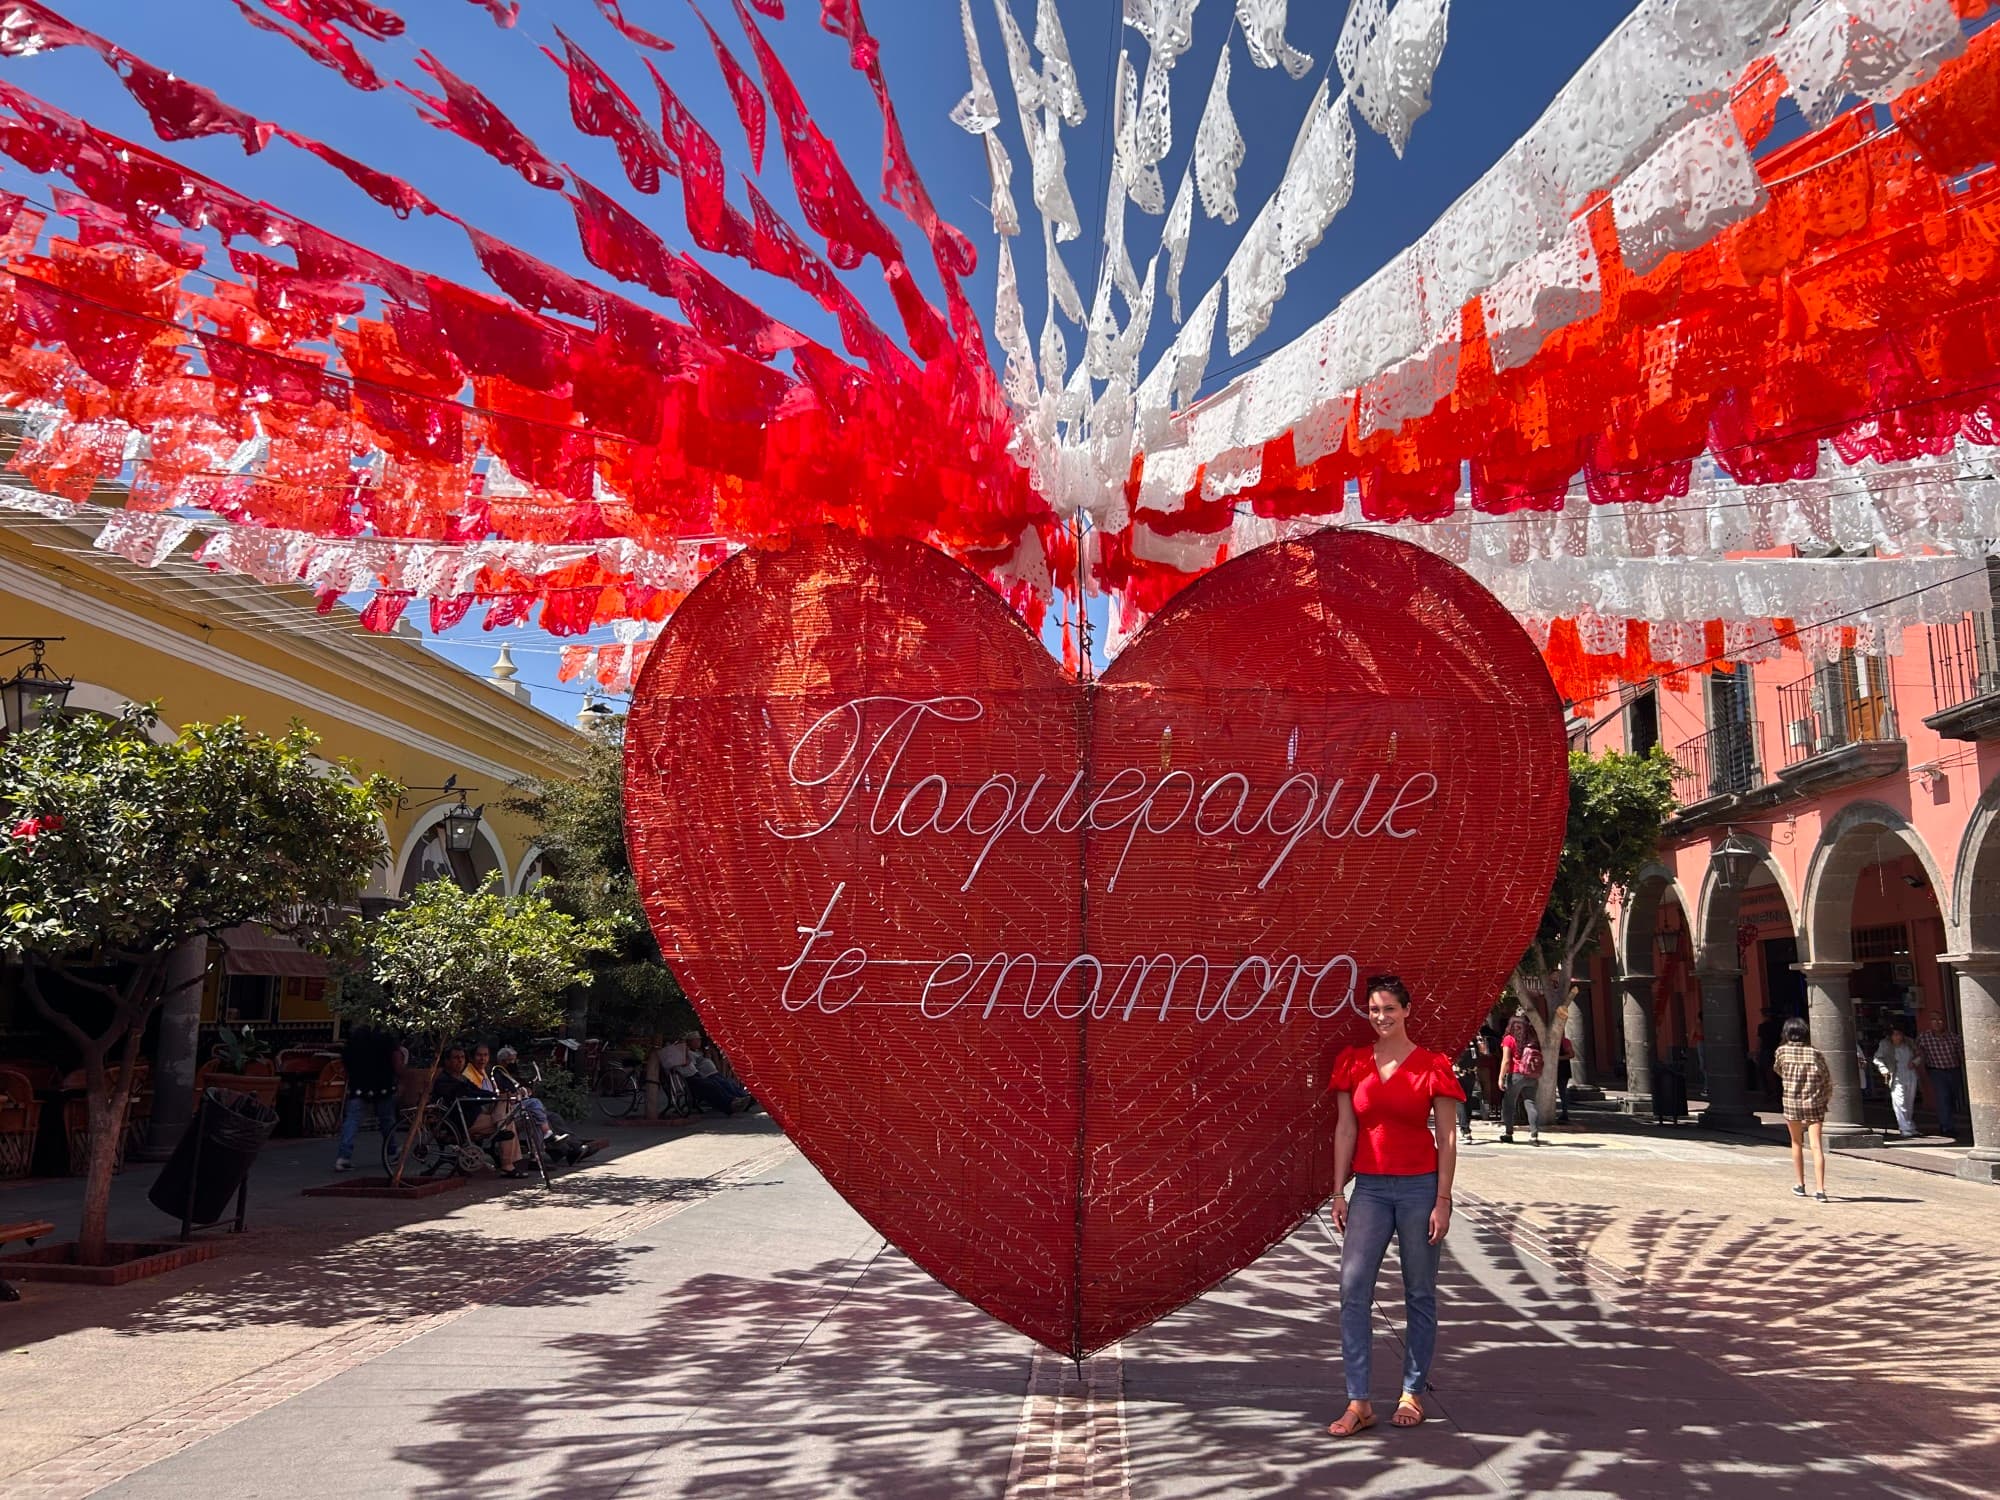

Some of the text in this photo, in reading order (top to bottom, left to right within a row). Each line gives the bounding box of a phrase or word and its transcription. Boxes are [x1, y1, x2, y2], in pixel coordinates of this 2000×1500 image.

[764, 695, 1439, 893] Tlaquepaque
[777, 881, 1370, 1024] te enamora
